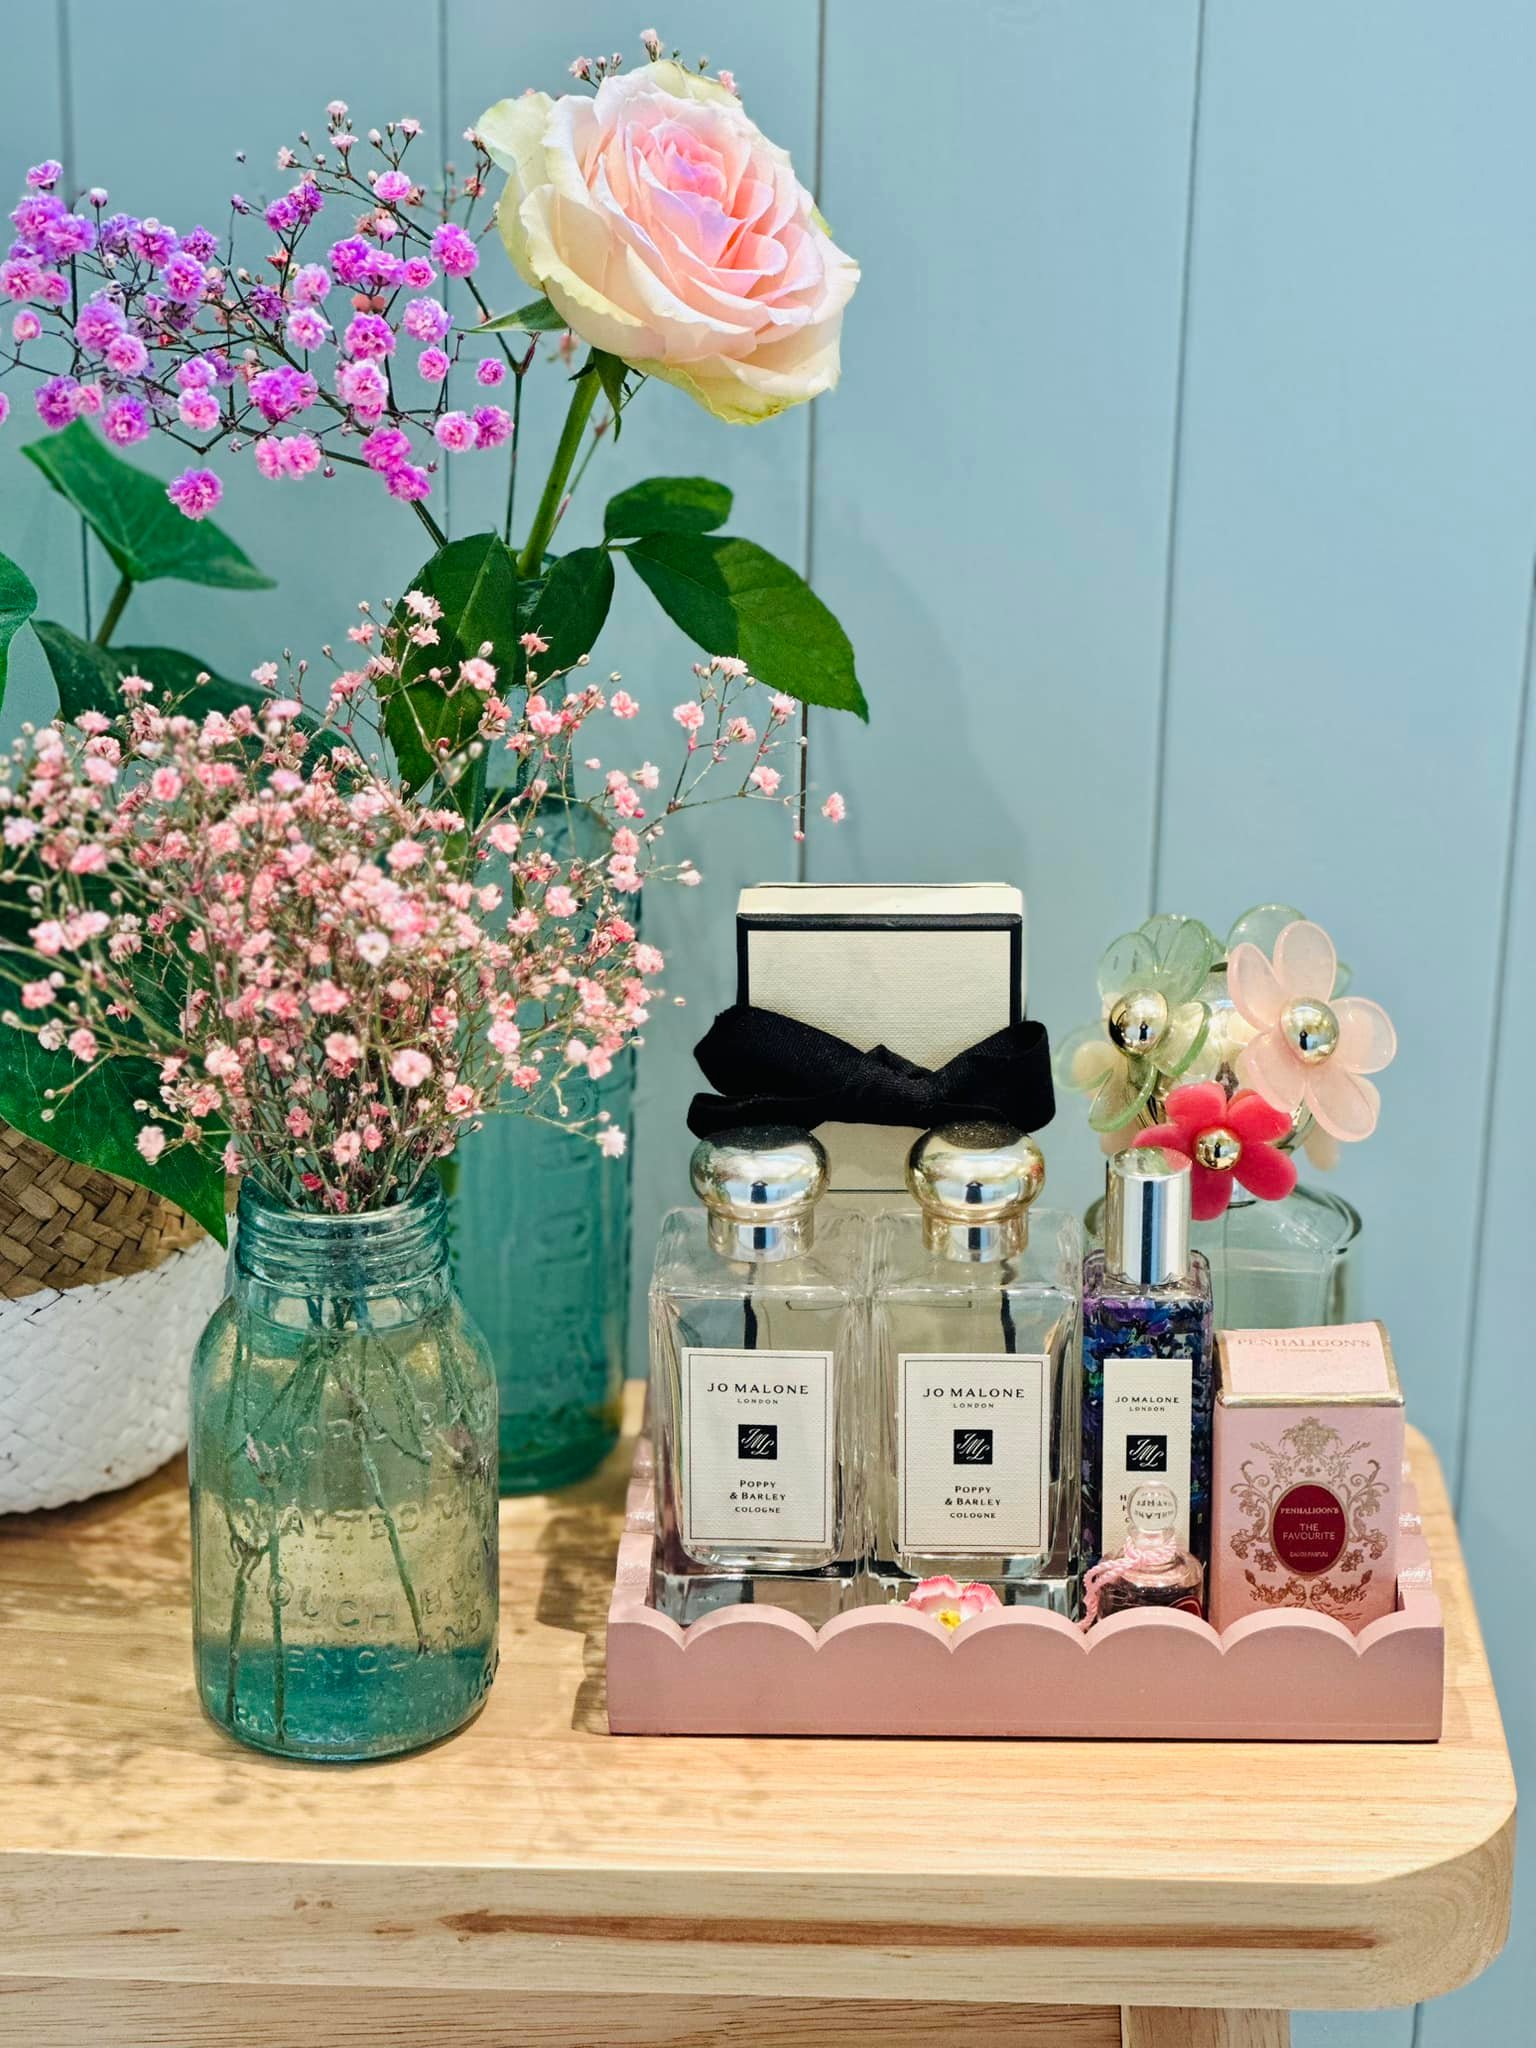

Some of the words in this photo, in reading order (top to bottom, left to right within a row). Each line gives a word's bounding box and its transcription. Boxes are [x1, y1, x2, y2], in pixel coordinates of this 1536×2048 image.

[707, 1382, 728, 1393] JO
[734, 1383, 809, 1395] MALONE
[922, 1387, 944, 1398] JO
[950, 1387, 1025, 1399] MALONE
[1115, 1396, 1129, 1404] JO
[1131, 1396, 1180, 1404] MALONE
[729, 1491, 738, 1501] &
[944, 1497, 953, 1506] &
[734, 1506, 782, 1514] COLOGNE
[949, 1511, 997, 1519] COLOGNE
[1299, 1522, 1320, 1532] THE
[1282, 1531, 1336, 1541] FAVOURITE
